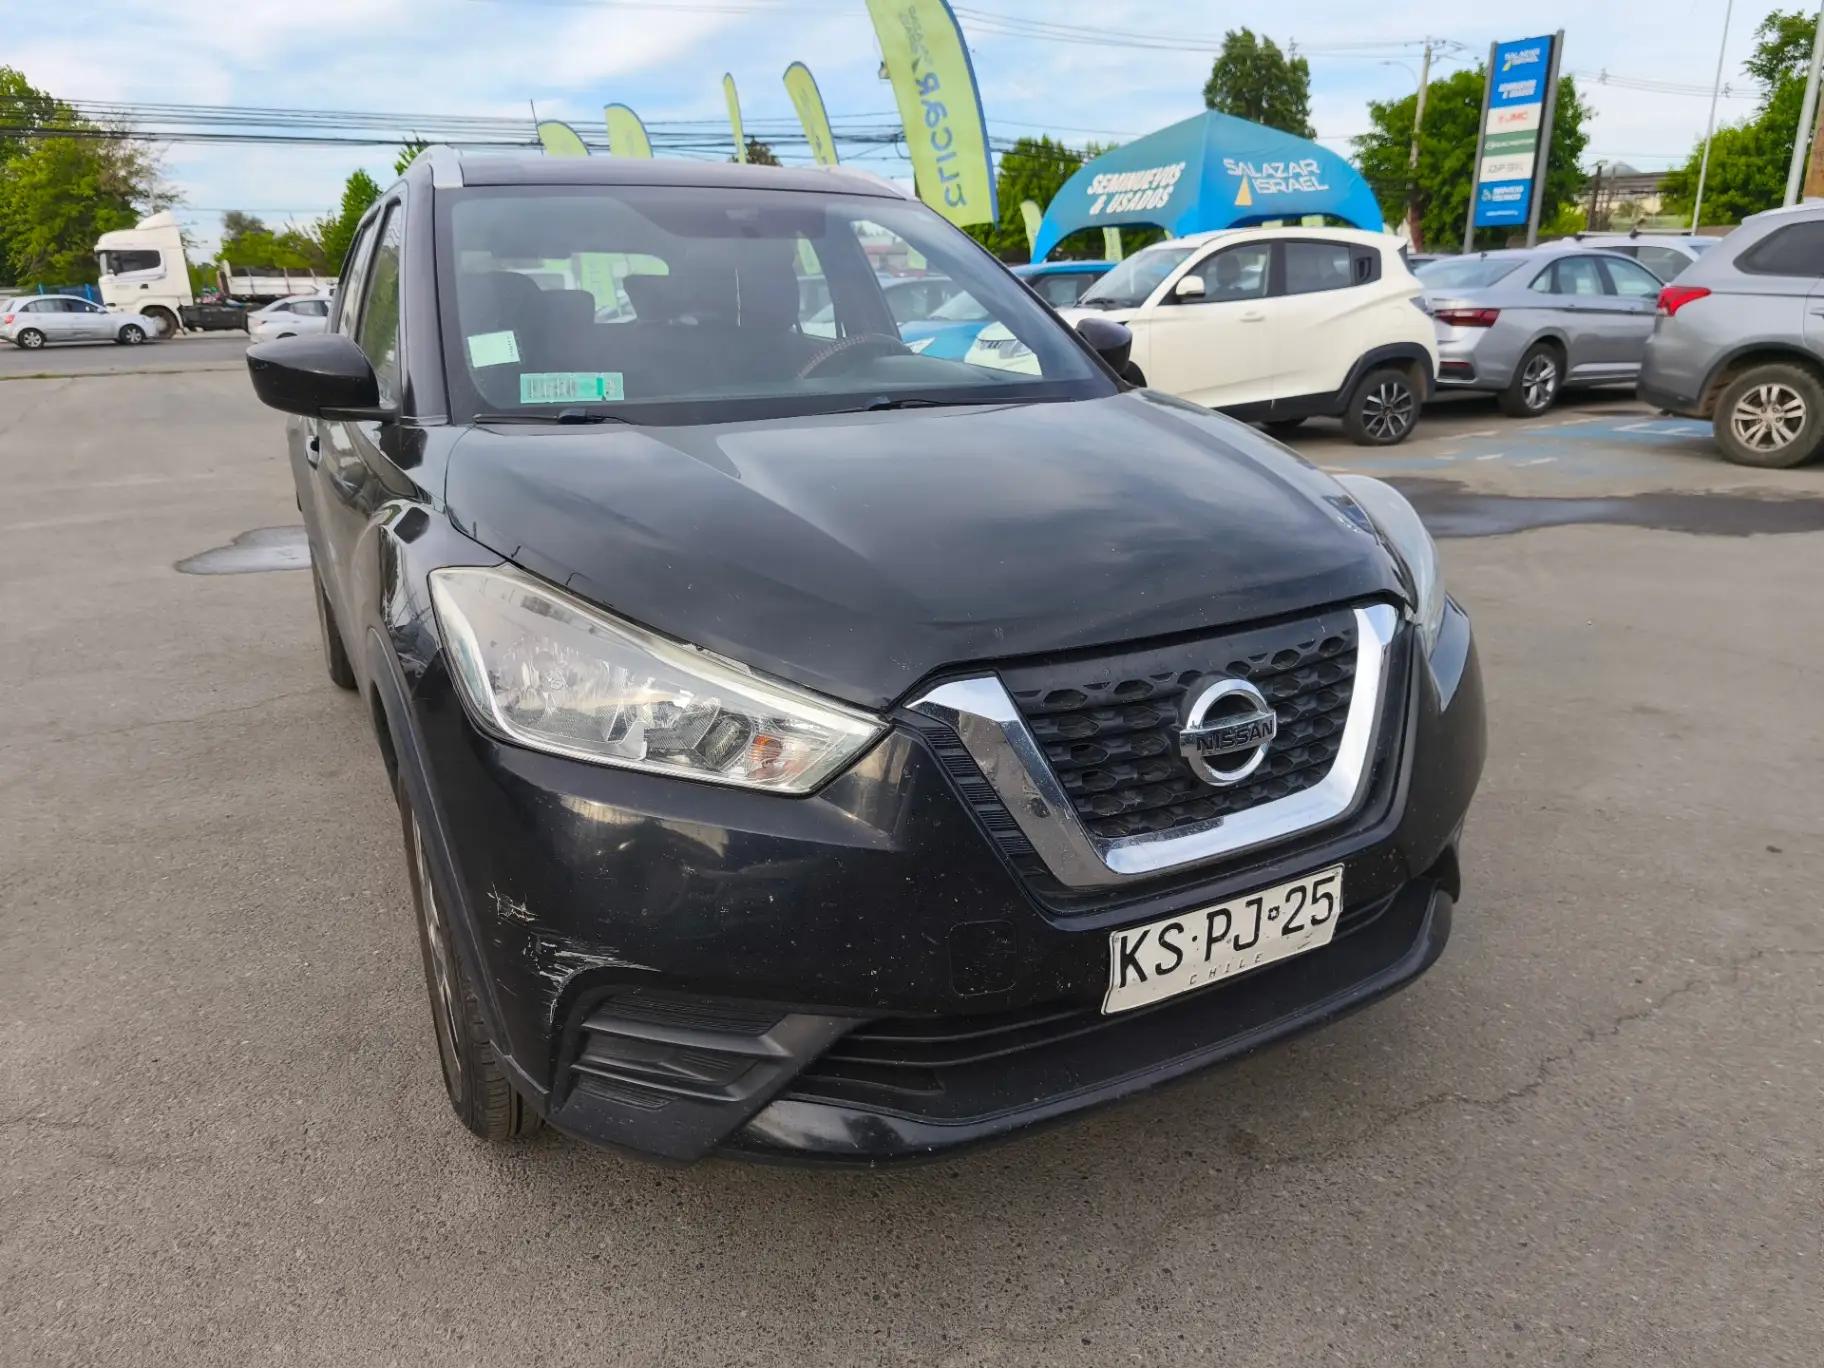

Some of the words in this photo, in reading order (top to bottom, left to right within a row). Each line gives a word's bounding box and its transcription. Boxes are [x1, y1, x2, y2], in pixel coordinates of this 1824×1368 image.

[1087, 162, 1186, 195] SEMINUEVOS
[1223, 158, 1320, 177] SALAZAR
[1106, 186, 1175, 213] USADOS
[1251, 176, 1329, 194] ISRAEL
[1197, 720, 1273, 751] NISSAN
[1189, 952, 1263, 985] CHILE
